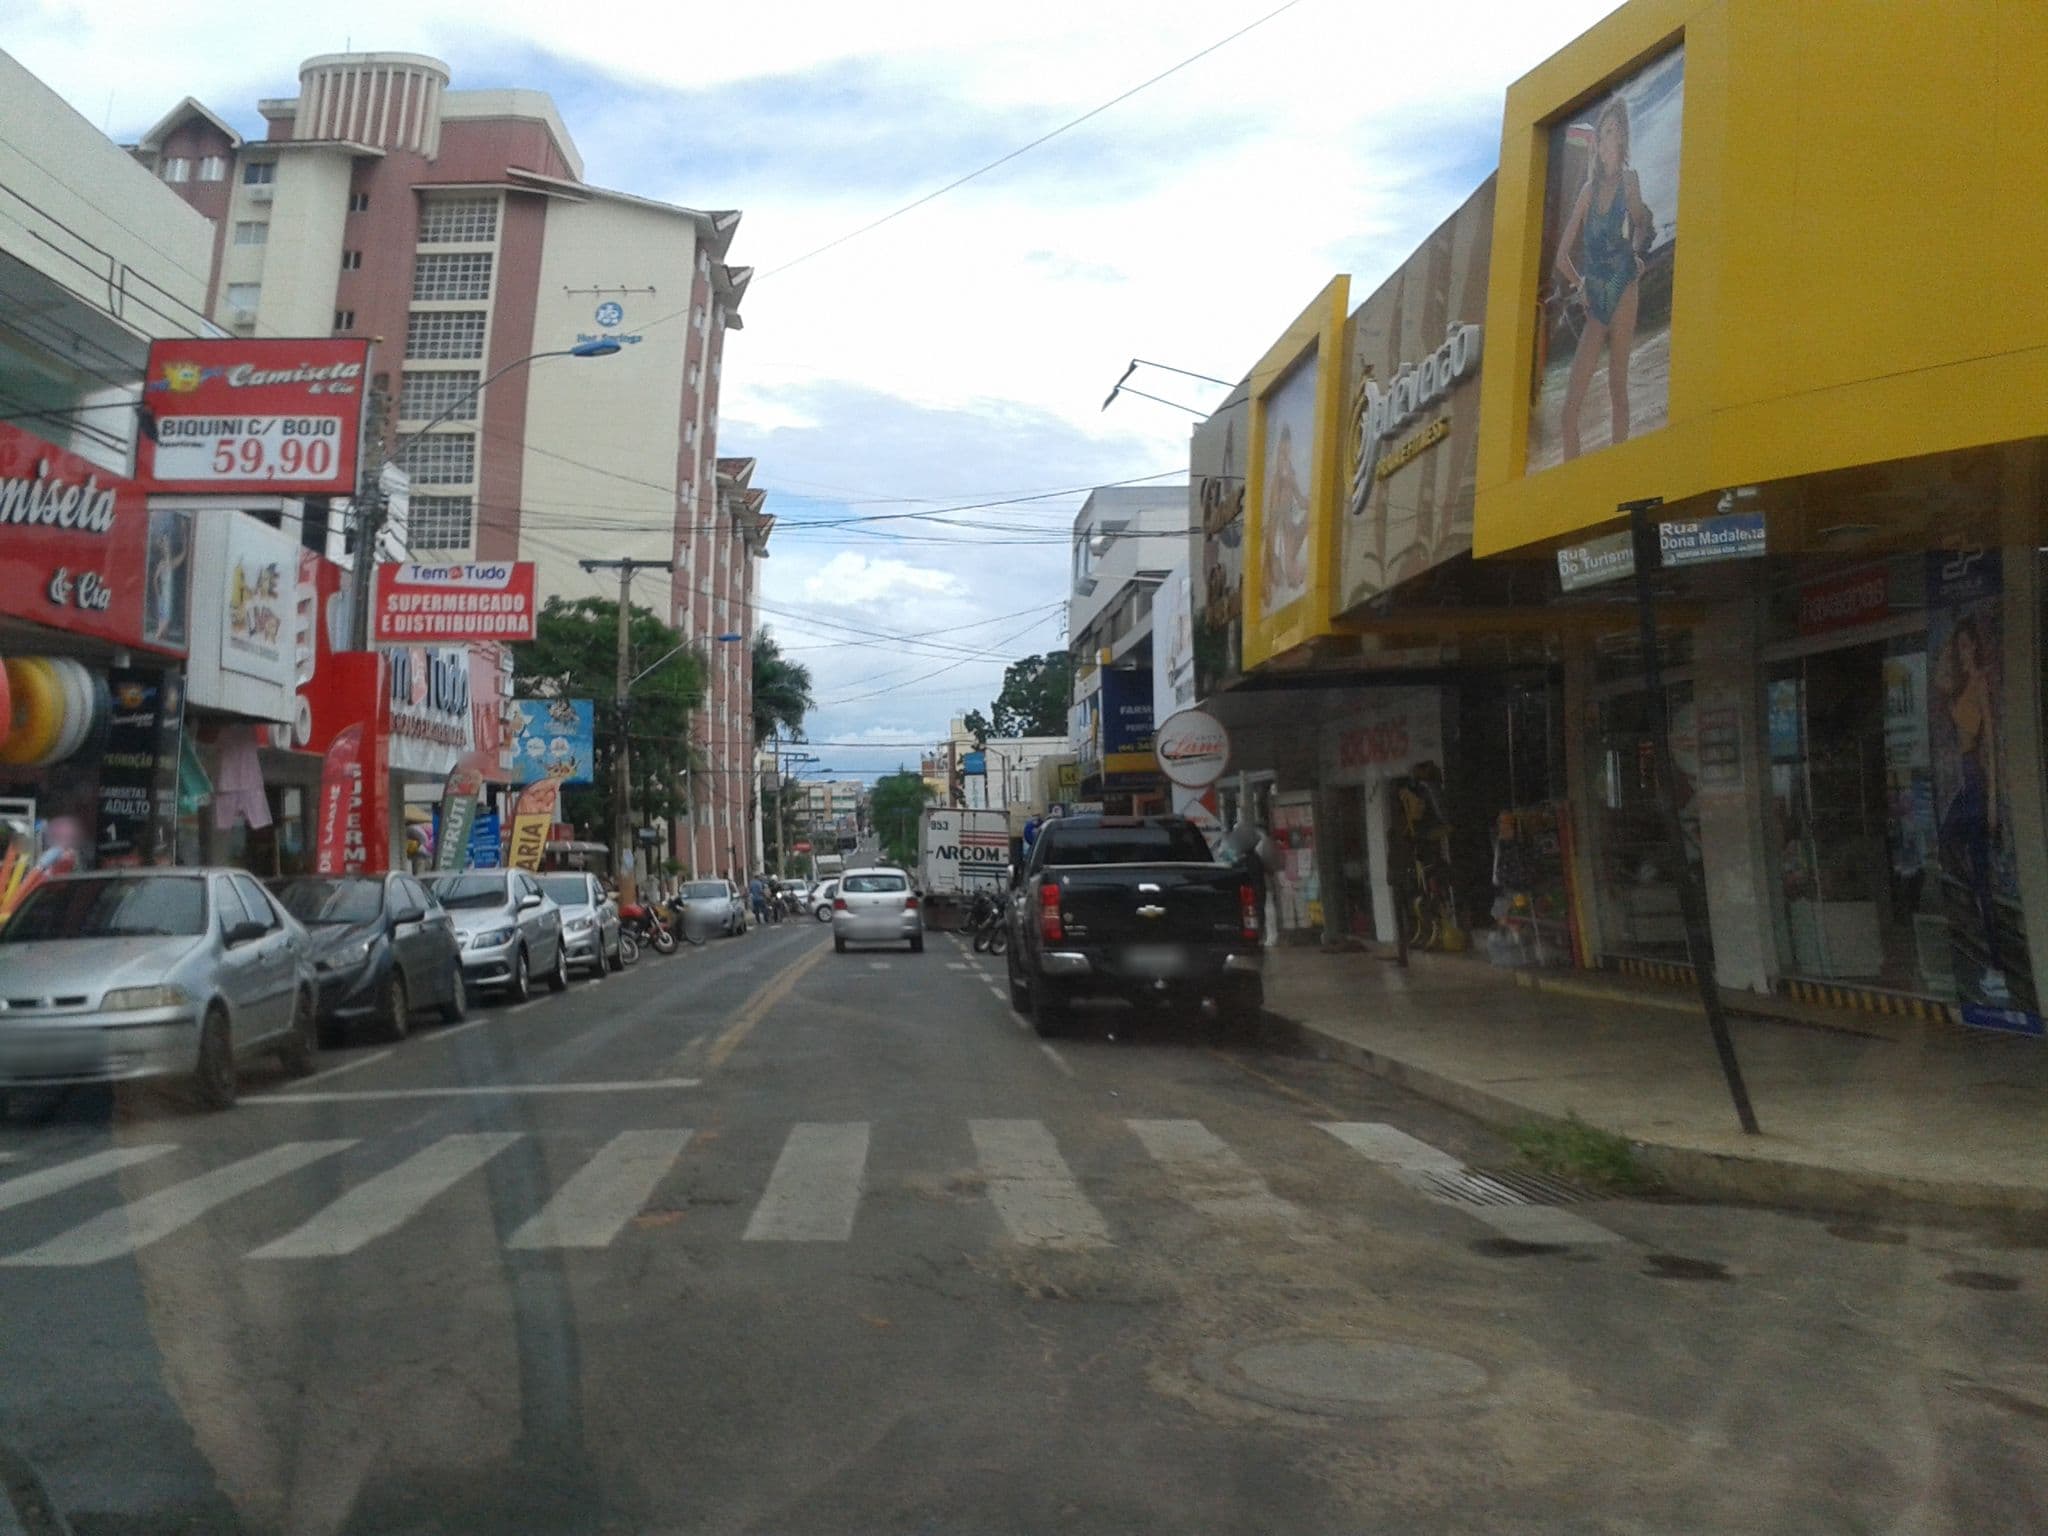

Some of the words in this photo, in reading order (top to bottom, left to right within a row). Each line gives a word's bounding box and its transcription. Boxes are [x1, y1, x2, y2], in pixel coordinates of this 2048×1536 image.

[226, 363, 361, 387] Camiseta
[161, 419, 243, 436] BIQUINI
[248, 419, 276, 436] C/
[282, 418, 336, 436] BOJO
[212, 438, 331, 479] 59,90
[1659, 523, 1698, 536] Rua
[1660, 536, 1695, 550] Dona
[1699, 528, 1766, 547] Madalena
[1557, 548, 1587, 563] Rua
[1559, 562, 1577, 577] Do
[1583, 549, 1635, 571] Turism
[411, 565, 447, 580] Tem
[465, 565, 506, 580] Tudo
[76, 571, 112, 610] Cia
[387, 593, 526, 613] SUPERMERCADO
[381, 614, 391, 633] E
[394, 615, 530, 633] DISTRIBUIDORA
[104, 798, 151, 815] ADULTO
[935, 845, 1000, 861] ARCOM
